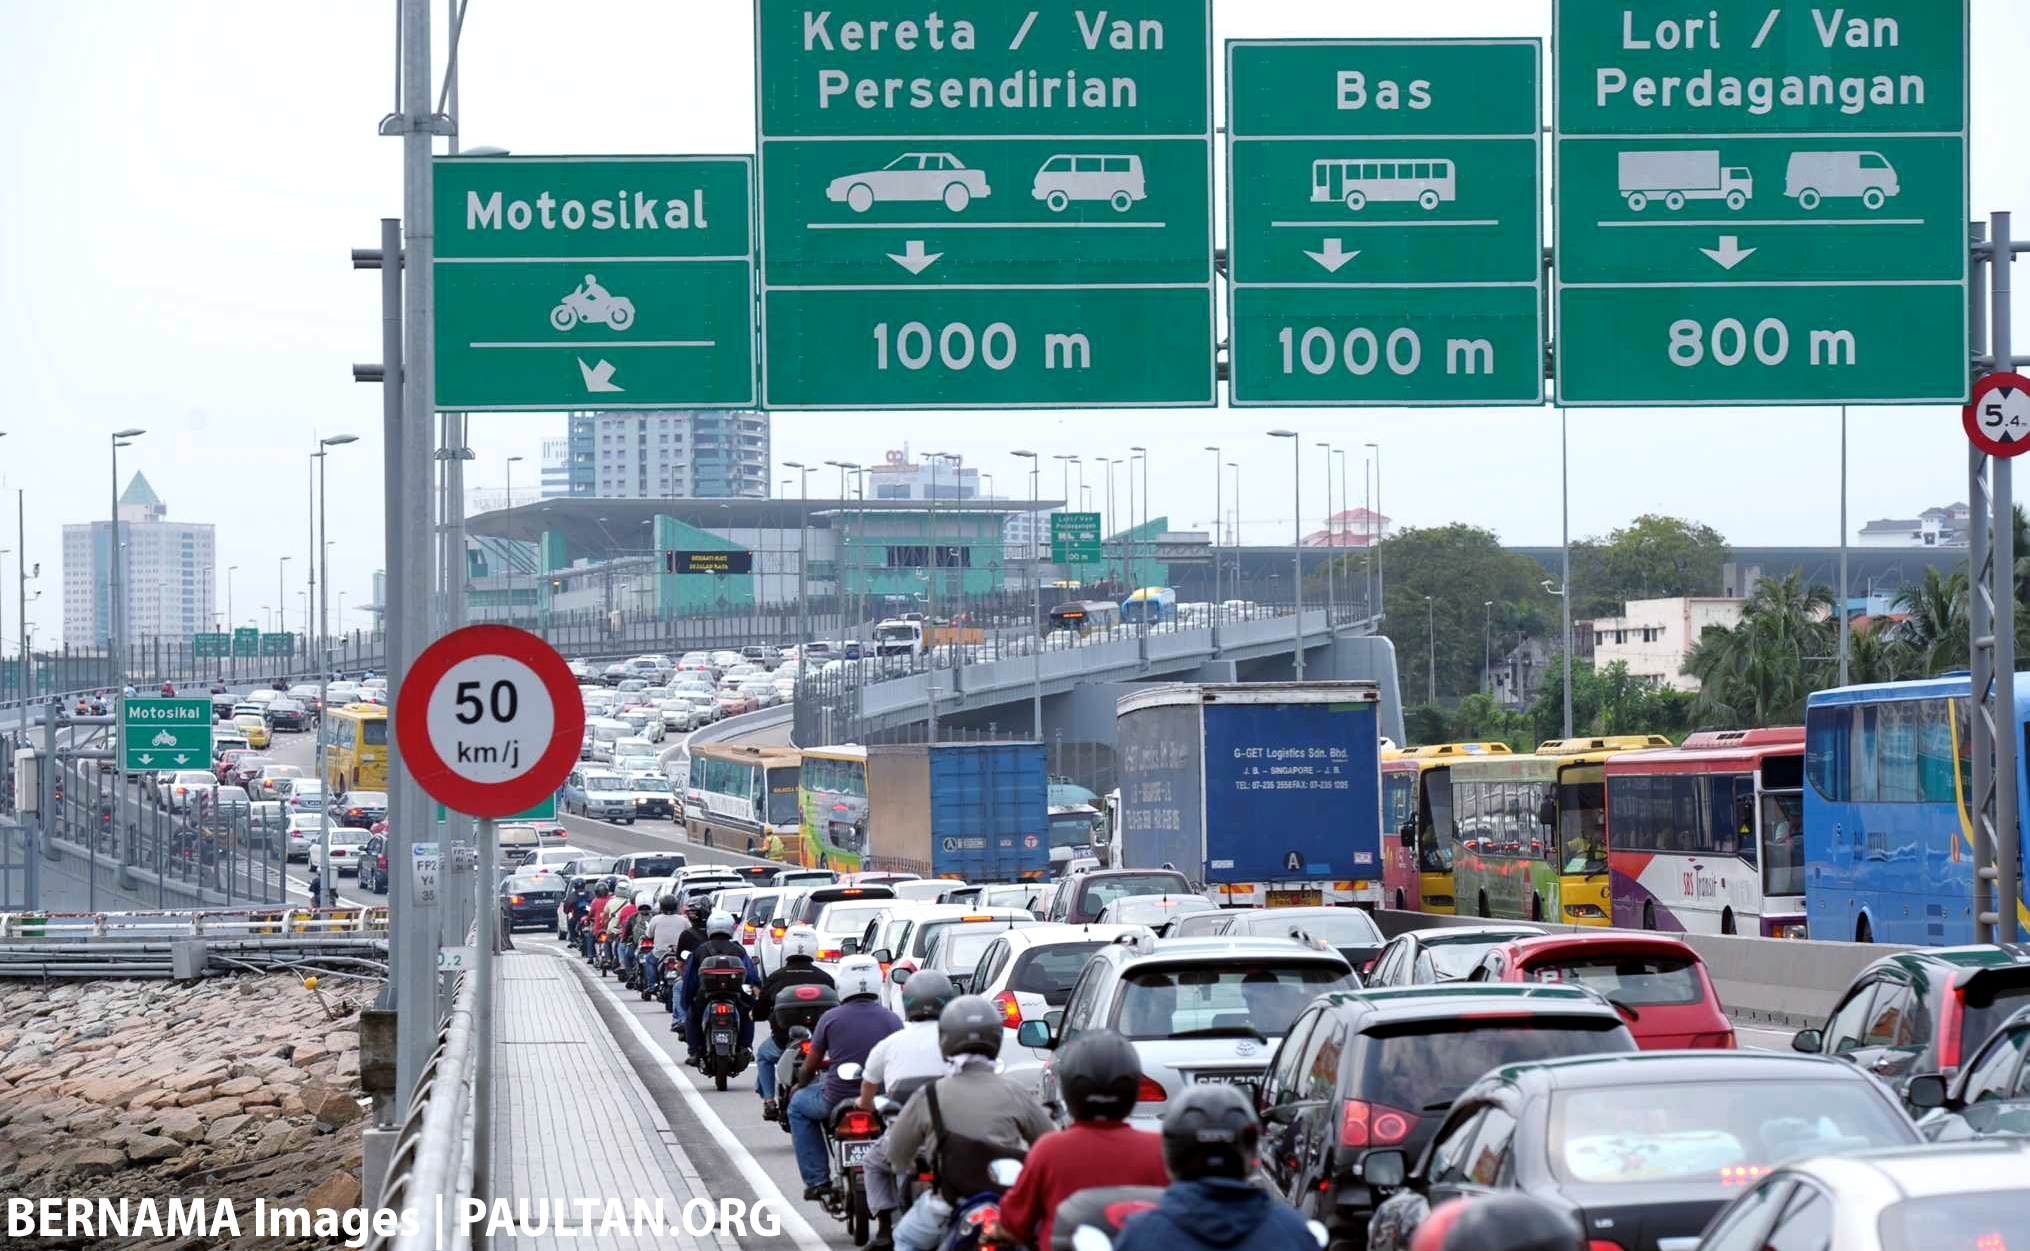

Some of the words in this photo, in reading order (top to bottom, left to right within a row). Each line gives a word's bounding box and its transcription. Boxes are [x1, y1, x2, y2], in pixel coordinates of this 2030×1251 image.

[804, 11, 976, 51] Kereta
[1009, 11, 1038, 50] /
[1075, 10, 1164, 50] Van
[1622, 10, 1721, 50] Lori
[1751, 9, 1780, 48] /
[1811, 8, 1899, 48] Van
[818, 69, 1138, 109] Persendirian
[1336, 70, 1433, 110] Bas
[1596, 67, 1925, 115] Perdagangan
[466, 188, 709, 231] Motosikal
[874, 321, 1017, 370] 1000
[1045, 333, 1090, 369] m
[1278, 326, 1422, 375] 1000
[1447, 339, 1494, 374] m
[1667, 317, 1790, 367] 800
[1810, 329, 1856, 365] m
[128, 706, 200, 719] Motosikal
[455, 679, 519, 725] 50
[457, 740, 519, 769] km/j
[1233, 747, 1263, 759] G-GET
[1266, 747, 1305, 761] Logistics
[1308, 747, 1327, 758] Sdn.
[1330, 747, 1348, 758] Bhd.
[1270, 766, 1314, 775] SINGAPORE
[416, 860, 437, 872] FP2
[1287, 852, 1300, 870] A
